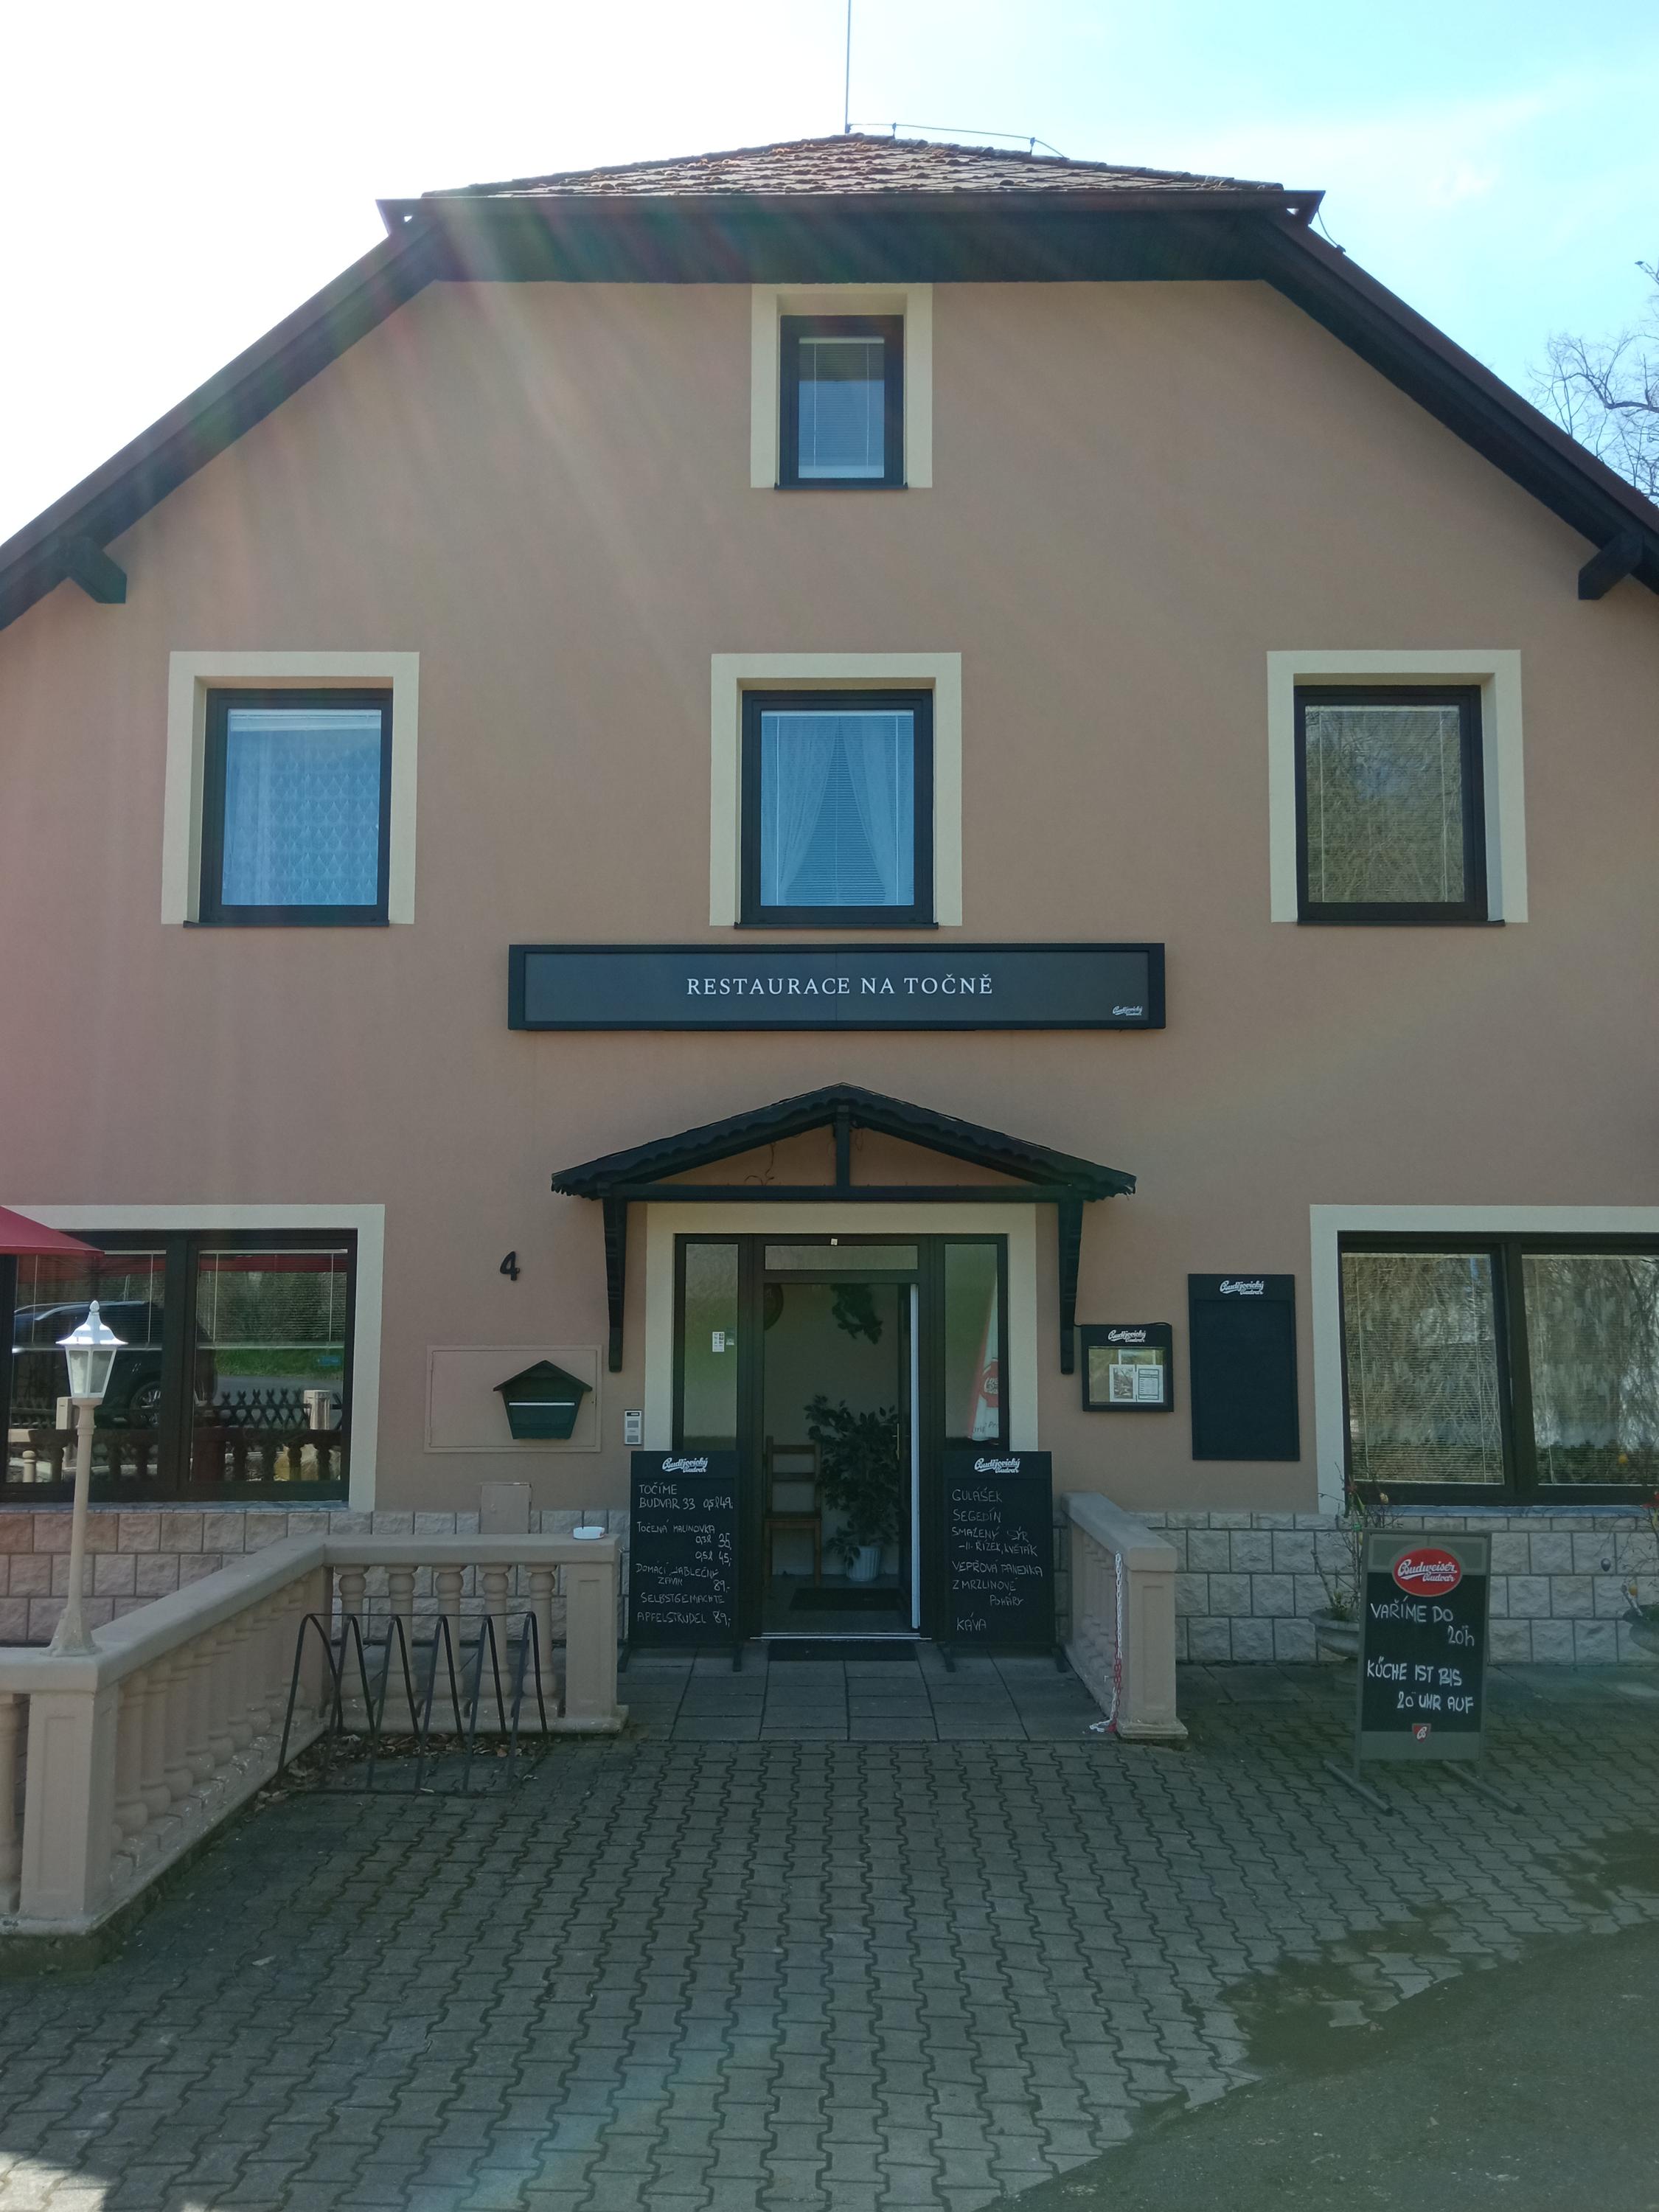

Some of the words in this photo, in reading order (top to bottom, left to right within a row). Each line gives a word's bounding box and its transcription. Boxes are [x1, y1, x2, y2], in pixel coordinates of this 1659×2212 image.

[686, 977, 850, 995] RESTAURACE
[861, 977, 895, 994] NA
[904, 973, 993, 994] TOČNĚ
[499, 1251, 521, 1281] 4
[639, 1481, 678, 1495] TOČÍME
[639, 1497, 681, 1509] BUDVAR
[683, 1498, 695, 1510] 33
[1397, 1559, 1458, 1579] Budweiser
[1422, 1573, 1455, 1582] Budvar
[636, 1611, 707, 1624] APFELSTRUDEL
[1370, 1596, 1427, 1622] VAŘÍME
[1432, 1606, 1454, 1622] DO
[956, 1612, 987, 1632] KÁVA
[1367, 1656, 1408, 1680] KÜCHE
[1415, 1664, 1434, 1683] IST
[1438, 1668, 1462, 1686] BIS
[1418, 1693, 1441, 1711] UHR
[1447, 1696, 1474, 1714] AUF
